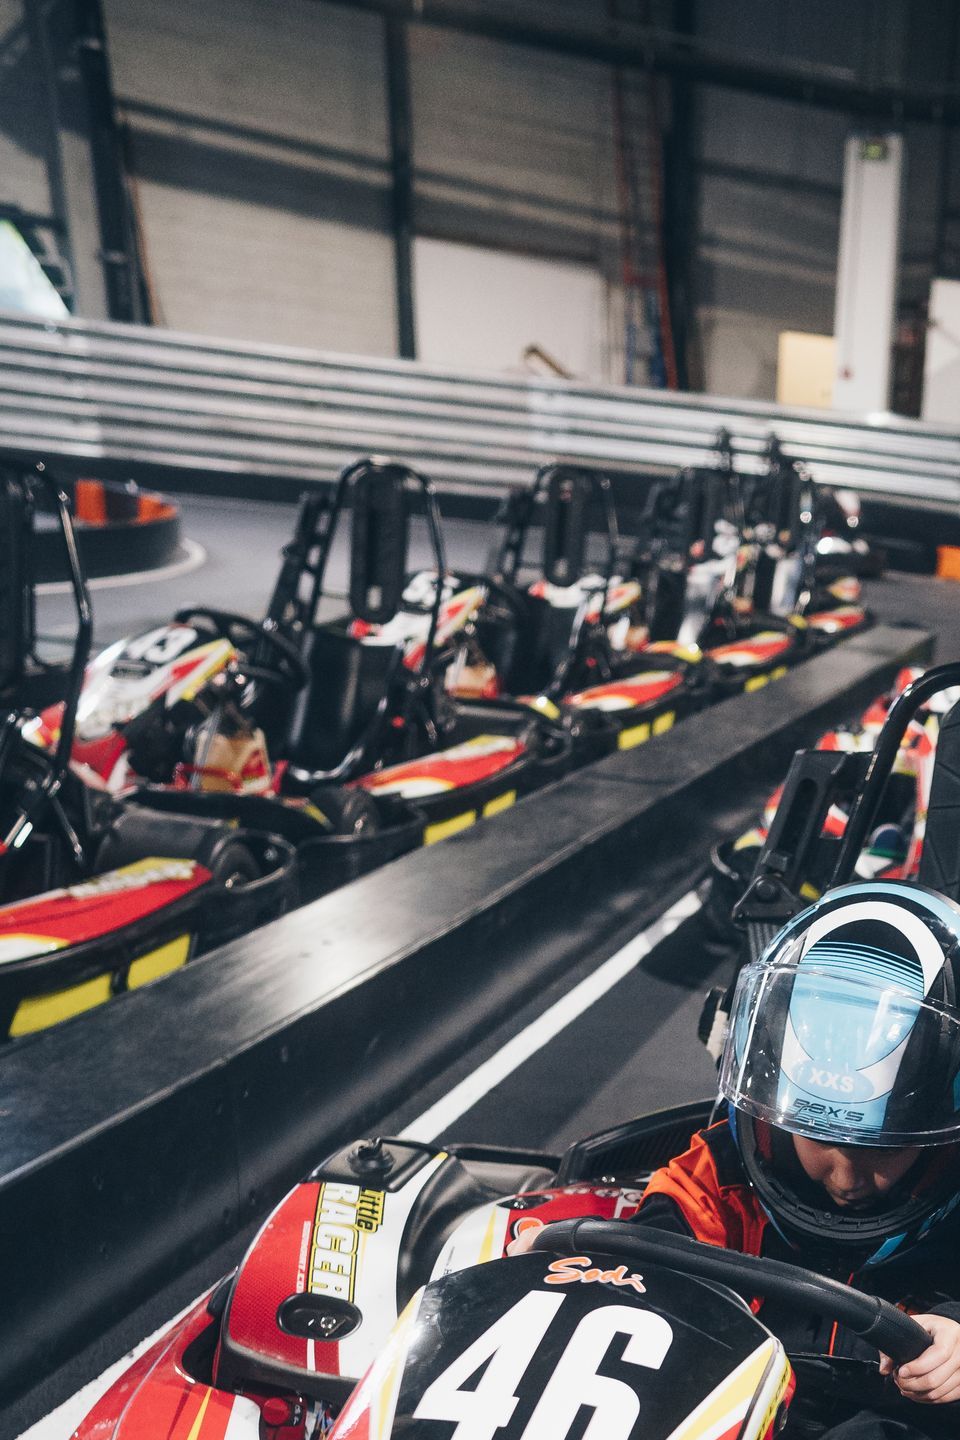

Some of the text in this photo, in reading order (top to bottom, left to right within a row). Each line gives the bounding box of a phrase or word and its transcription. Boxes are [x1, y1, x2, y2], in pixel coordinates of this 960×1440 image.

[808, 1066, 855, 1093] XXS
[311, 1182, 361, 1302] RACER
[544, 1256, 648, 1293] Sodi
